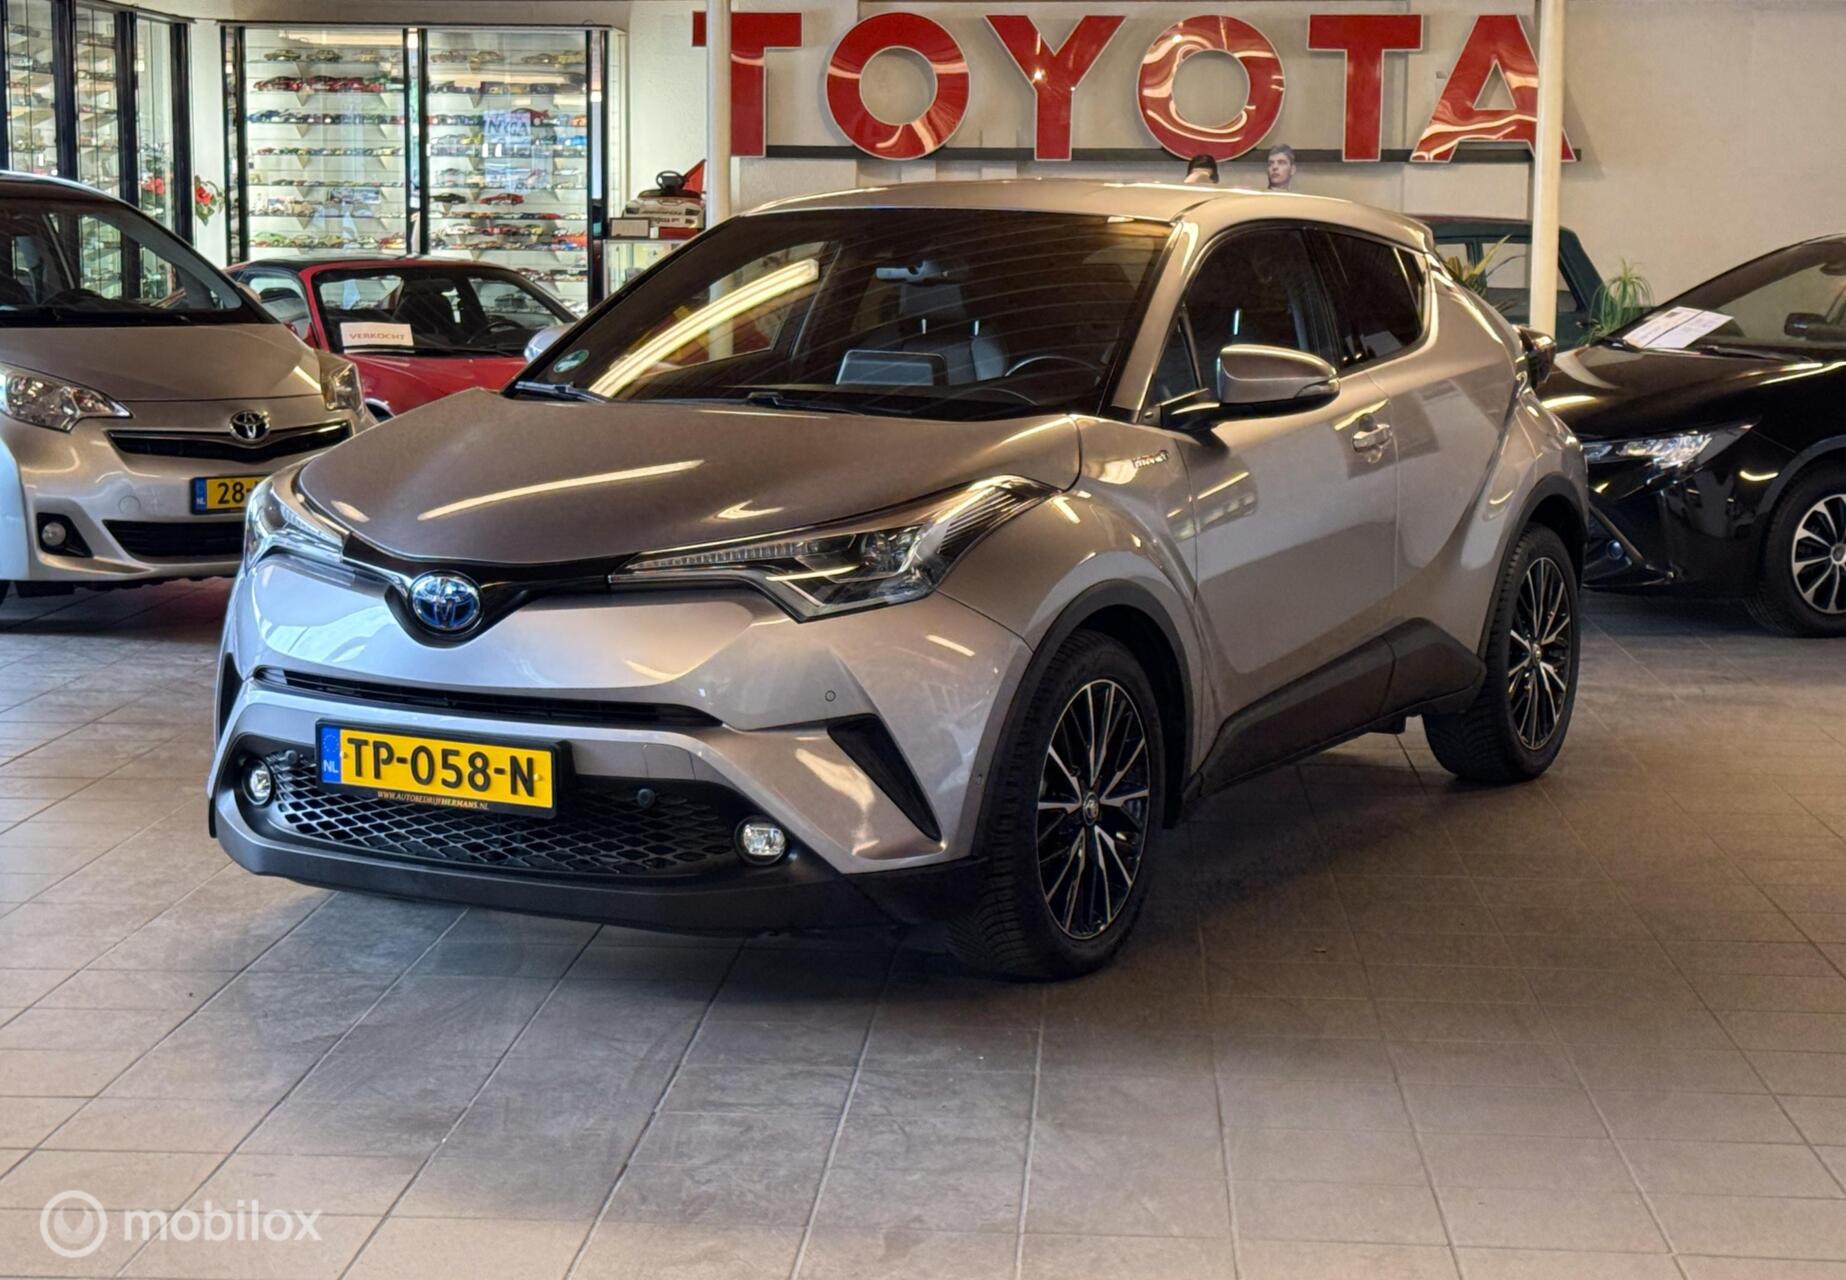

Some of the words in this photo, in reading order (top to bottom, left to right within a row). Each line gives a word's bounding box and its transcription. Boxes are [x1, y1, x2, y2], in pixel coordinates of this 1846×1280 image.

[691, 11, 1577, 162] TOYOTA
[348, 332, 406, 341] VERKOCHT
[323, 759, 339, 774] NL
[347, 736, 535, 798] TP-058-N
